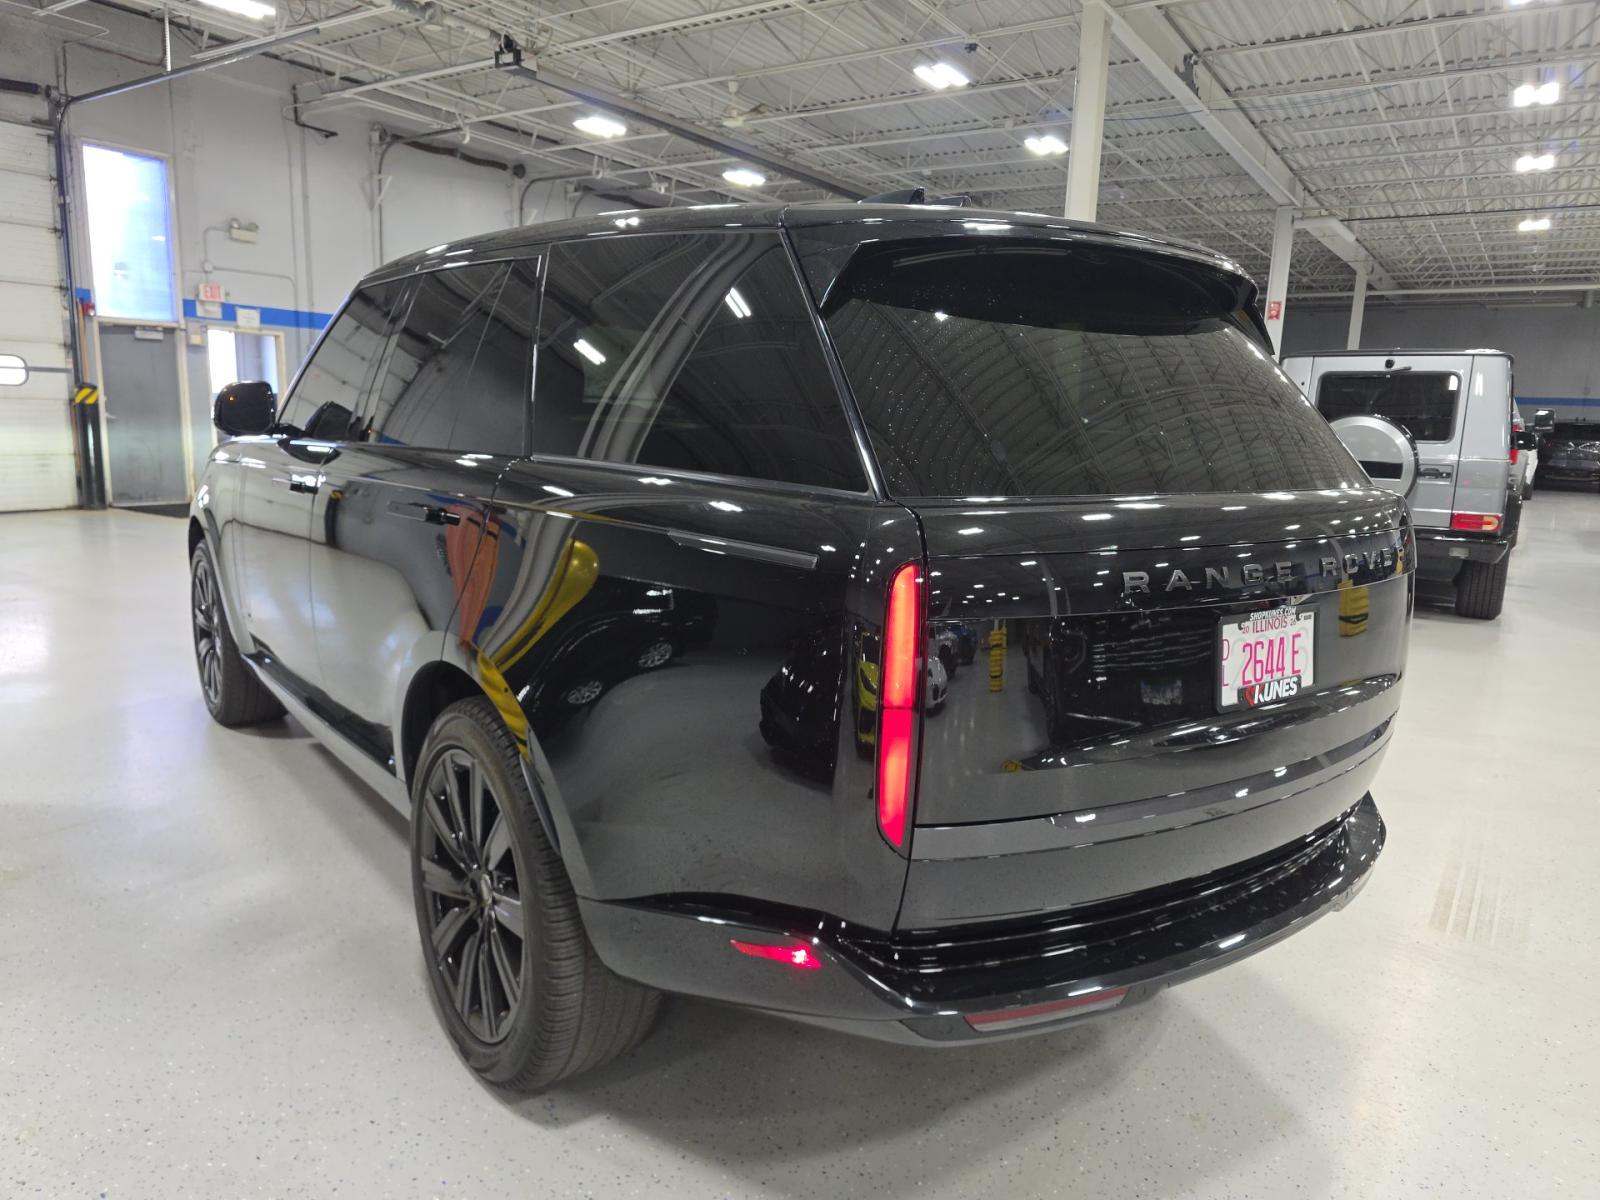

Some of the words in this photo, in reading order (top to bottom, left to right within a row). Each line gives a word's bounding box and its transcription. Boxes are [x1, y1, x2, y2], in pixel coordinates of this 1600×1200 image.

[1122, 560, 1293, 593] RANGE
[1252, 617, 1288, 633] ILLINOIS
[1242, 636, 1286, 686] 2644
[1291, 633, 1302, 675] E
[1254, 676, 1298, 704] KUNES
